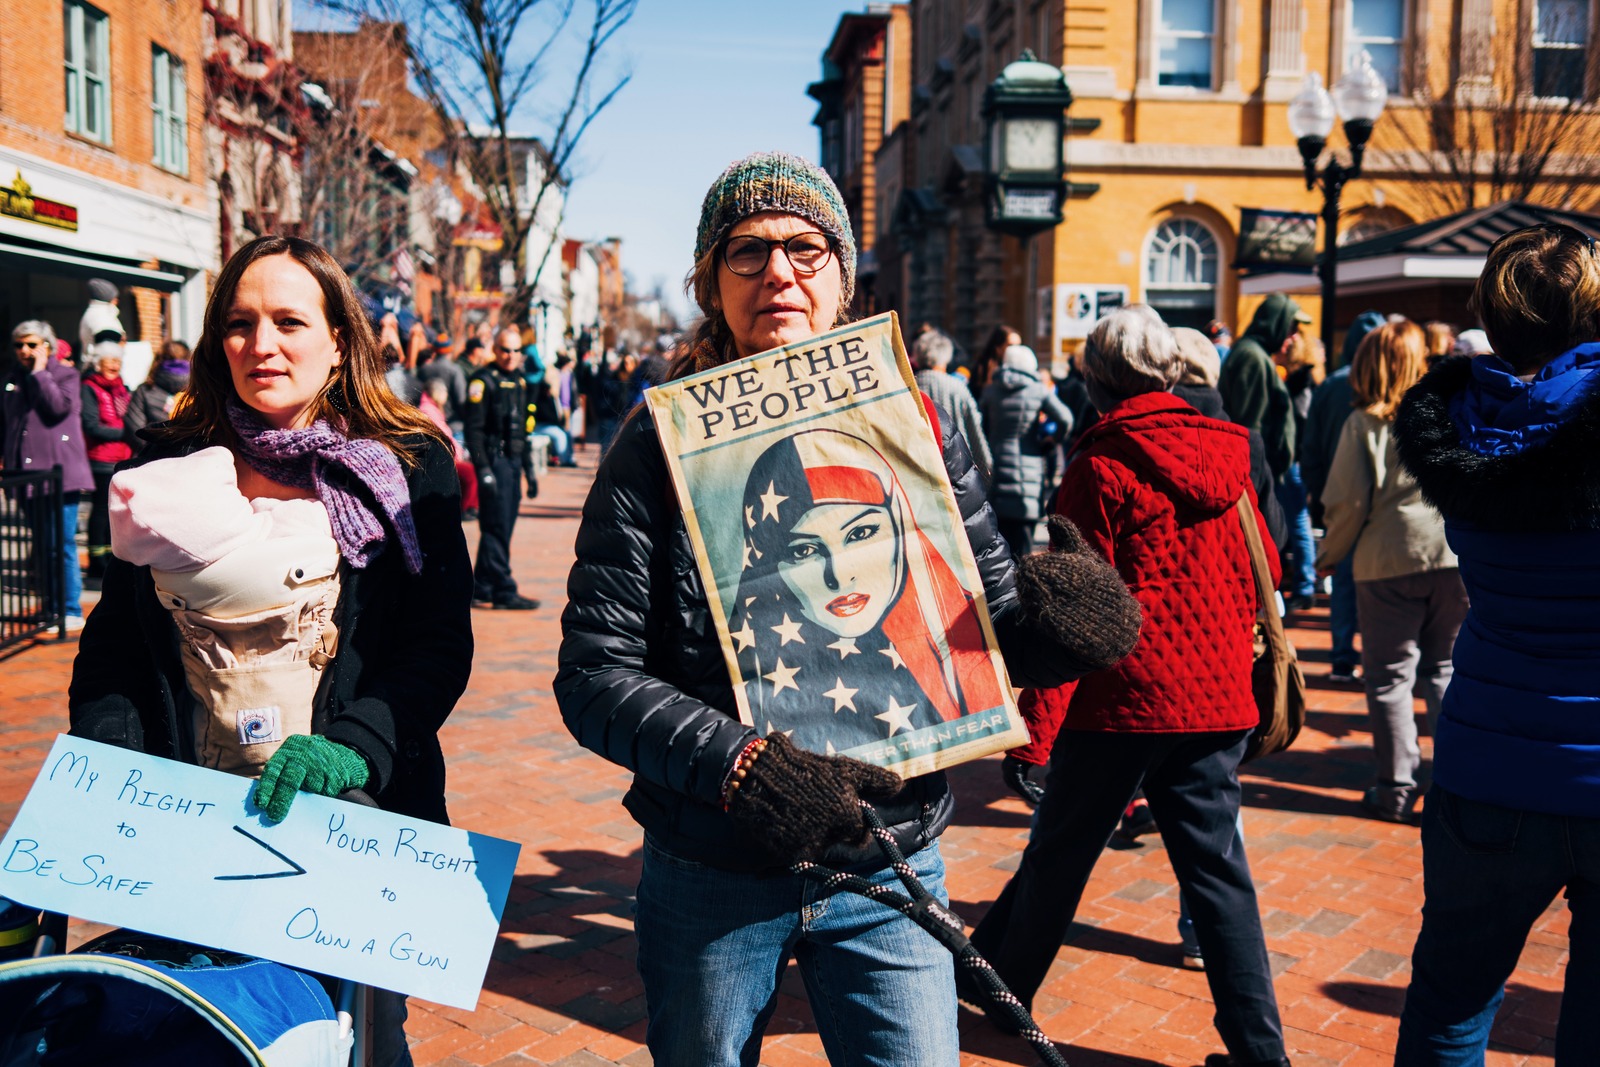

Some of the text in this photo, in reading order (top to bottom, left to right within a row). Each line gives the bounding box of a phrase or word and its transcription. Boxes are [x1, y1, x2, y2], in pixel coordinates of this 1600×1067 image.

[684, 336, 869, 409] WE THE
[697, 365, 879, 440] PEOPLE
[854, 745, 897, 764] TER
[899, 730, 952, 753] THAN
[955, 714, 1004, 738] FEAR
[117, 769, 216, 817] RIGHT
[116, 821, 137, 838] to
[325, 813, 479, 873] YOUR RIGHT
[3, 838, 154, 896] BE SAFE
[381, 887, 397, 902] to
[286, 907, 351, 950] OWN
[389, 932, 449, 971] GUN
